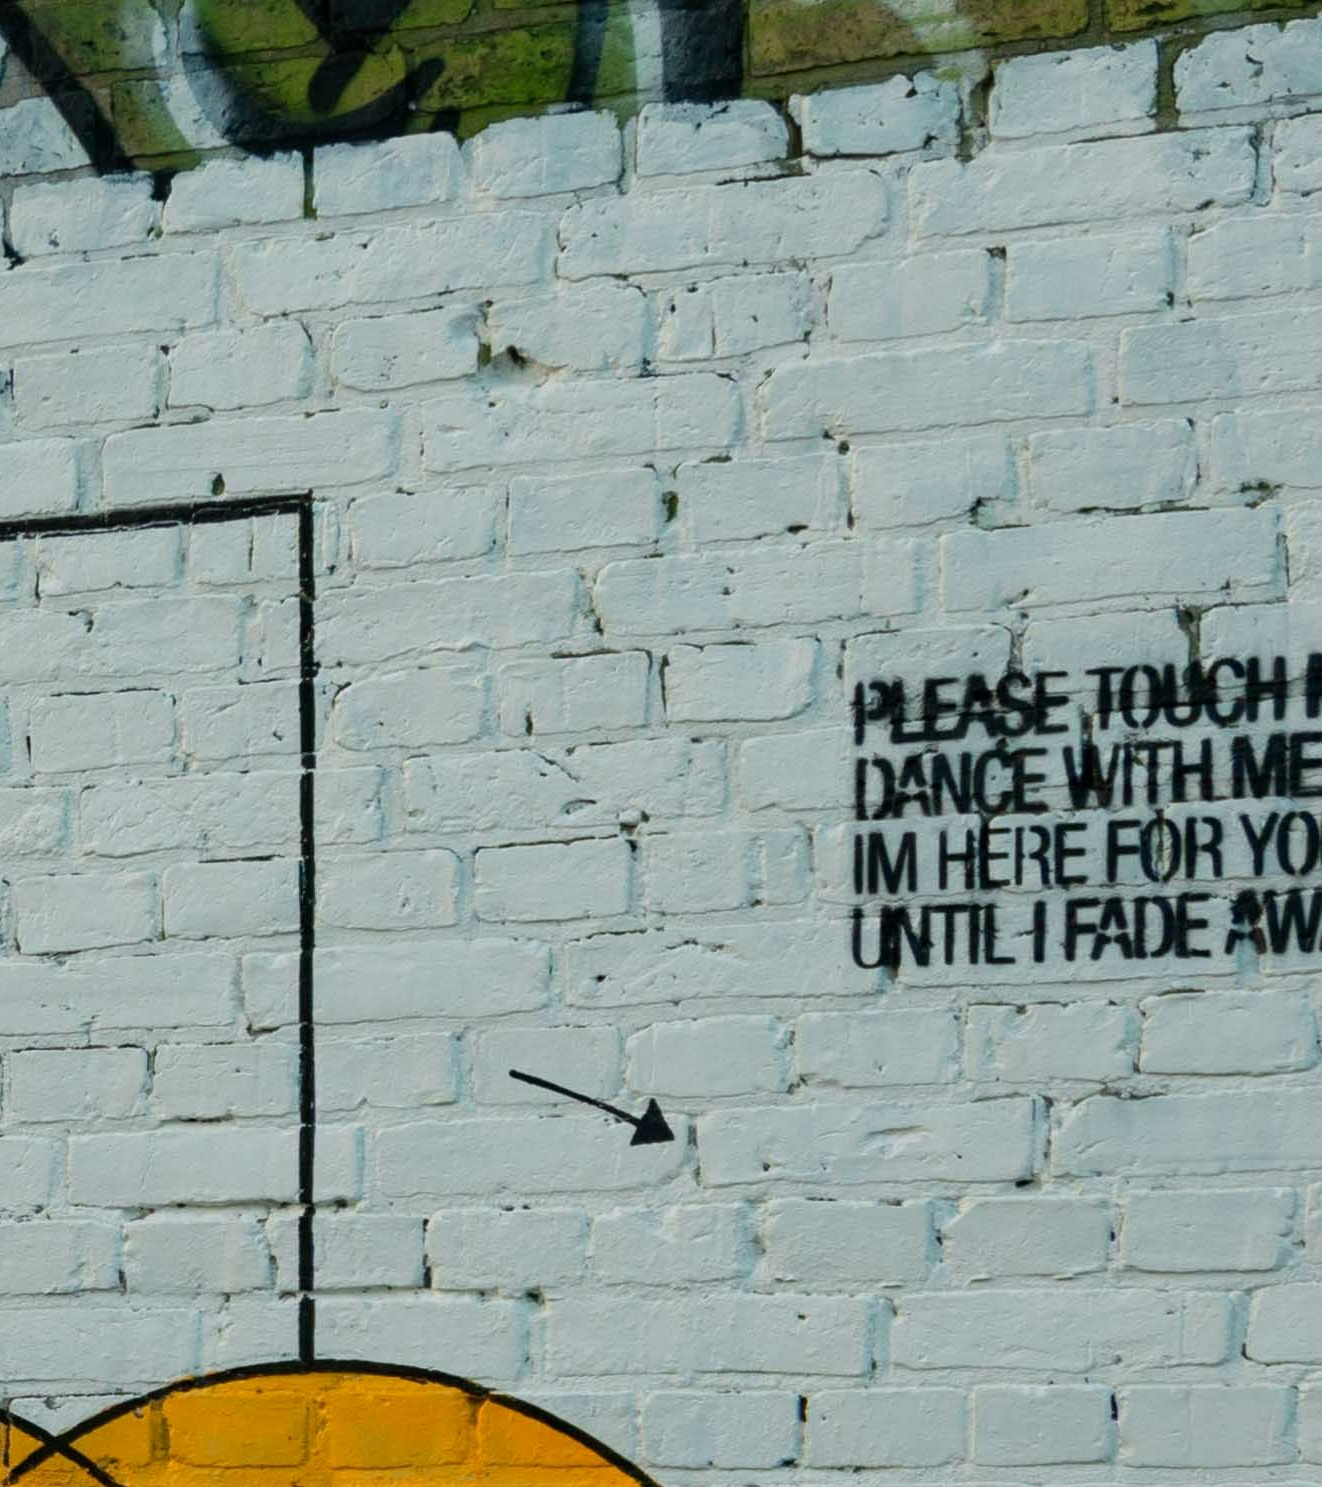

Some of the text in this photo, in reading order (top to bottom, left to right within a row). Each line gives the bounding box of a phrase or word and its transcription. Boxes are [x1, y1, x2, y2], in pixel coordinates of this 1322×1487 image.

[855, 672, 1069, 746] PLEASE
[1086, 654, 1288, 730] TOUCH
[855, 731, 1322, 821] DANCE WITH ME
[855, 832, 917, 895] IM
[938, 823, 1088, 890] HERE
[1107, 815, 1223, 882] FOR
[852, 890, 1322, 970] UNTIL I FADE AW
